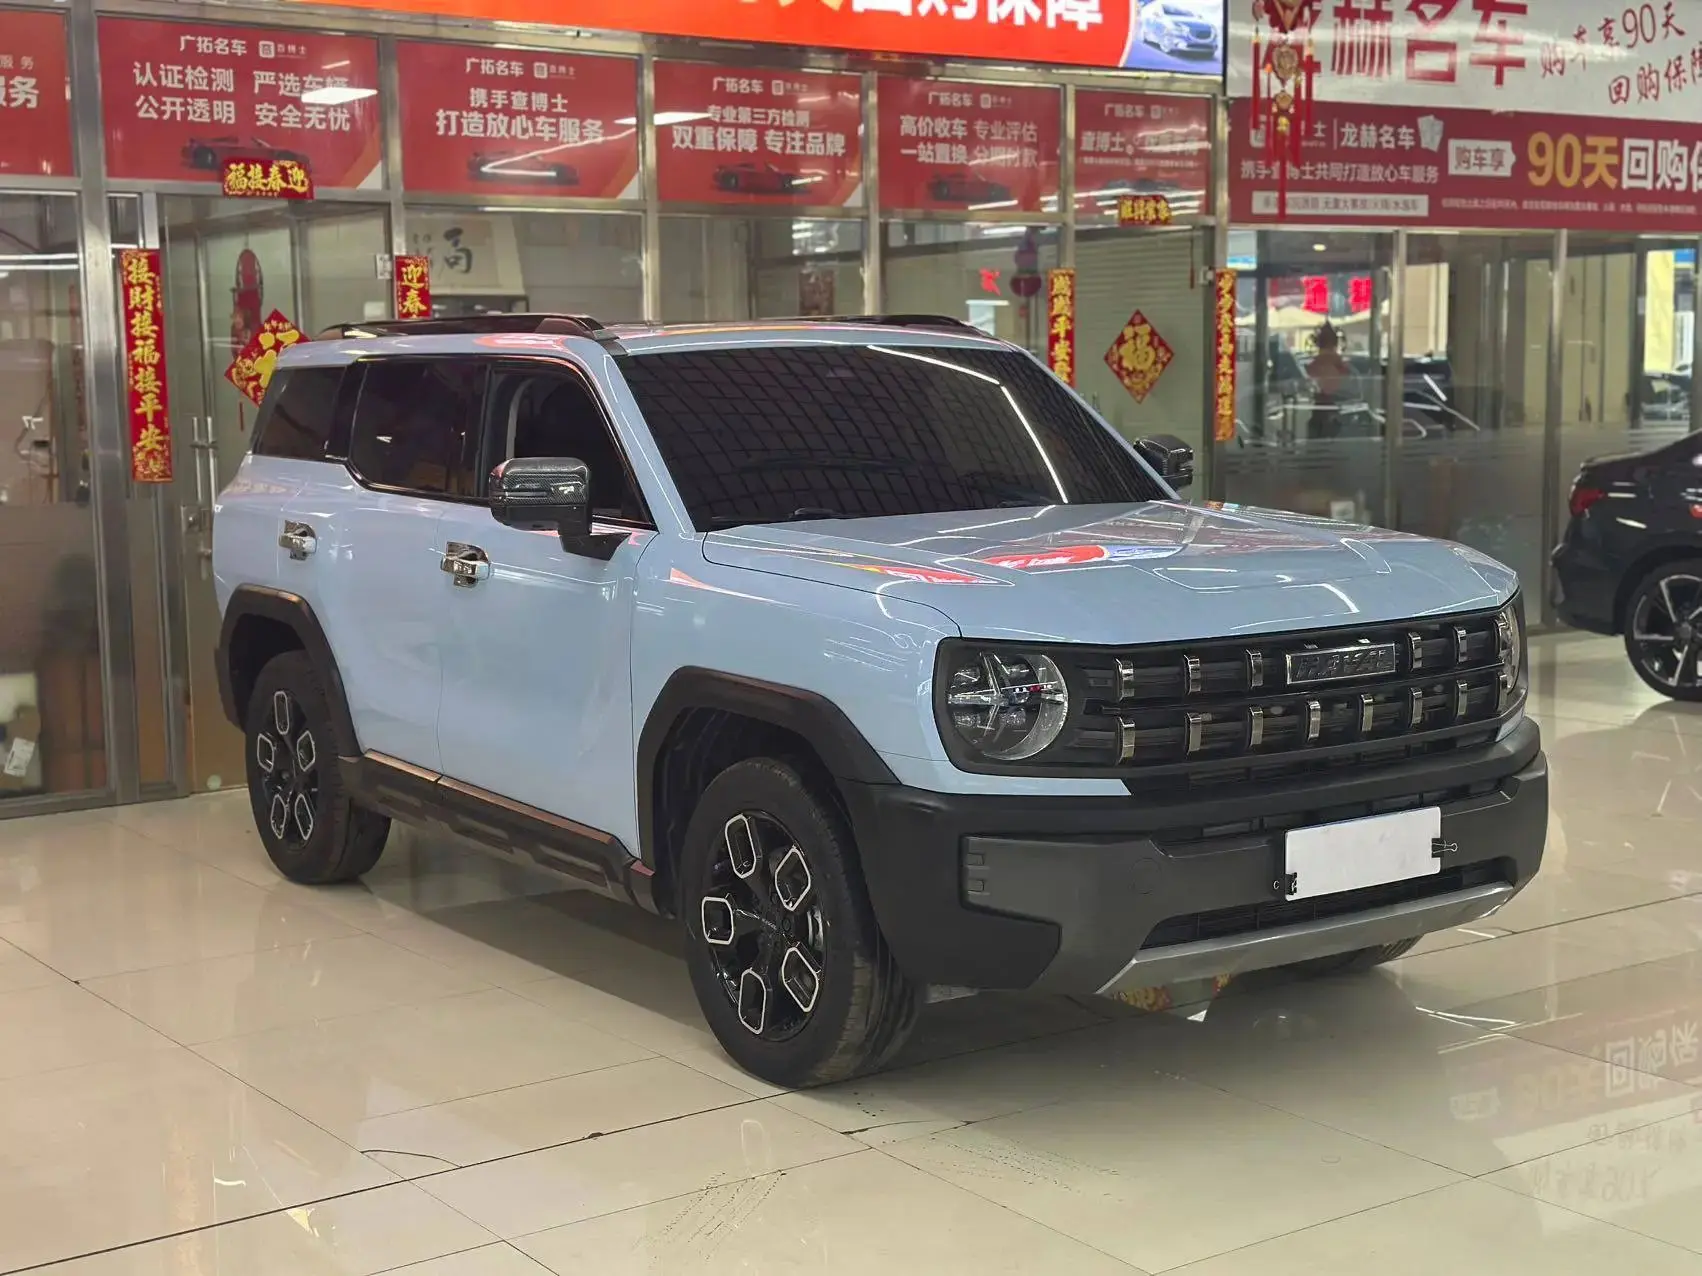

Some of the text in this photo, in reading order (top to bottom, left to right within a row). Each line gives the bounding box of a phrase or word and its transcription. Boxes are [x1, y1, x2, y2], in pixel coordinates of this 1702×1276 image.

[180, 35, 247, 56] 广拓名车
[133, 62, 234, 93] 认证检测
[465, 58, 524, 77] 广拓名车
[0, 75, 39, 109] 务
[469, 87, 568, 113] 携手查博士
[135, 95, 351, 131] 公开透明 安全无忧
[436, 109, 604, 144] 打造放心车服务
[900, 114, 1038, 143] 高价收车 专业评估
[672, 125, 846, 157] 双重保障 专注品牌
[900, 142, 969, 165] 一站置换
[400, 263, 427, 319] 迎春
[1119, 323, 1156, 371] 福
